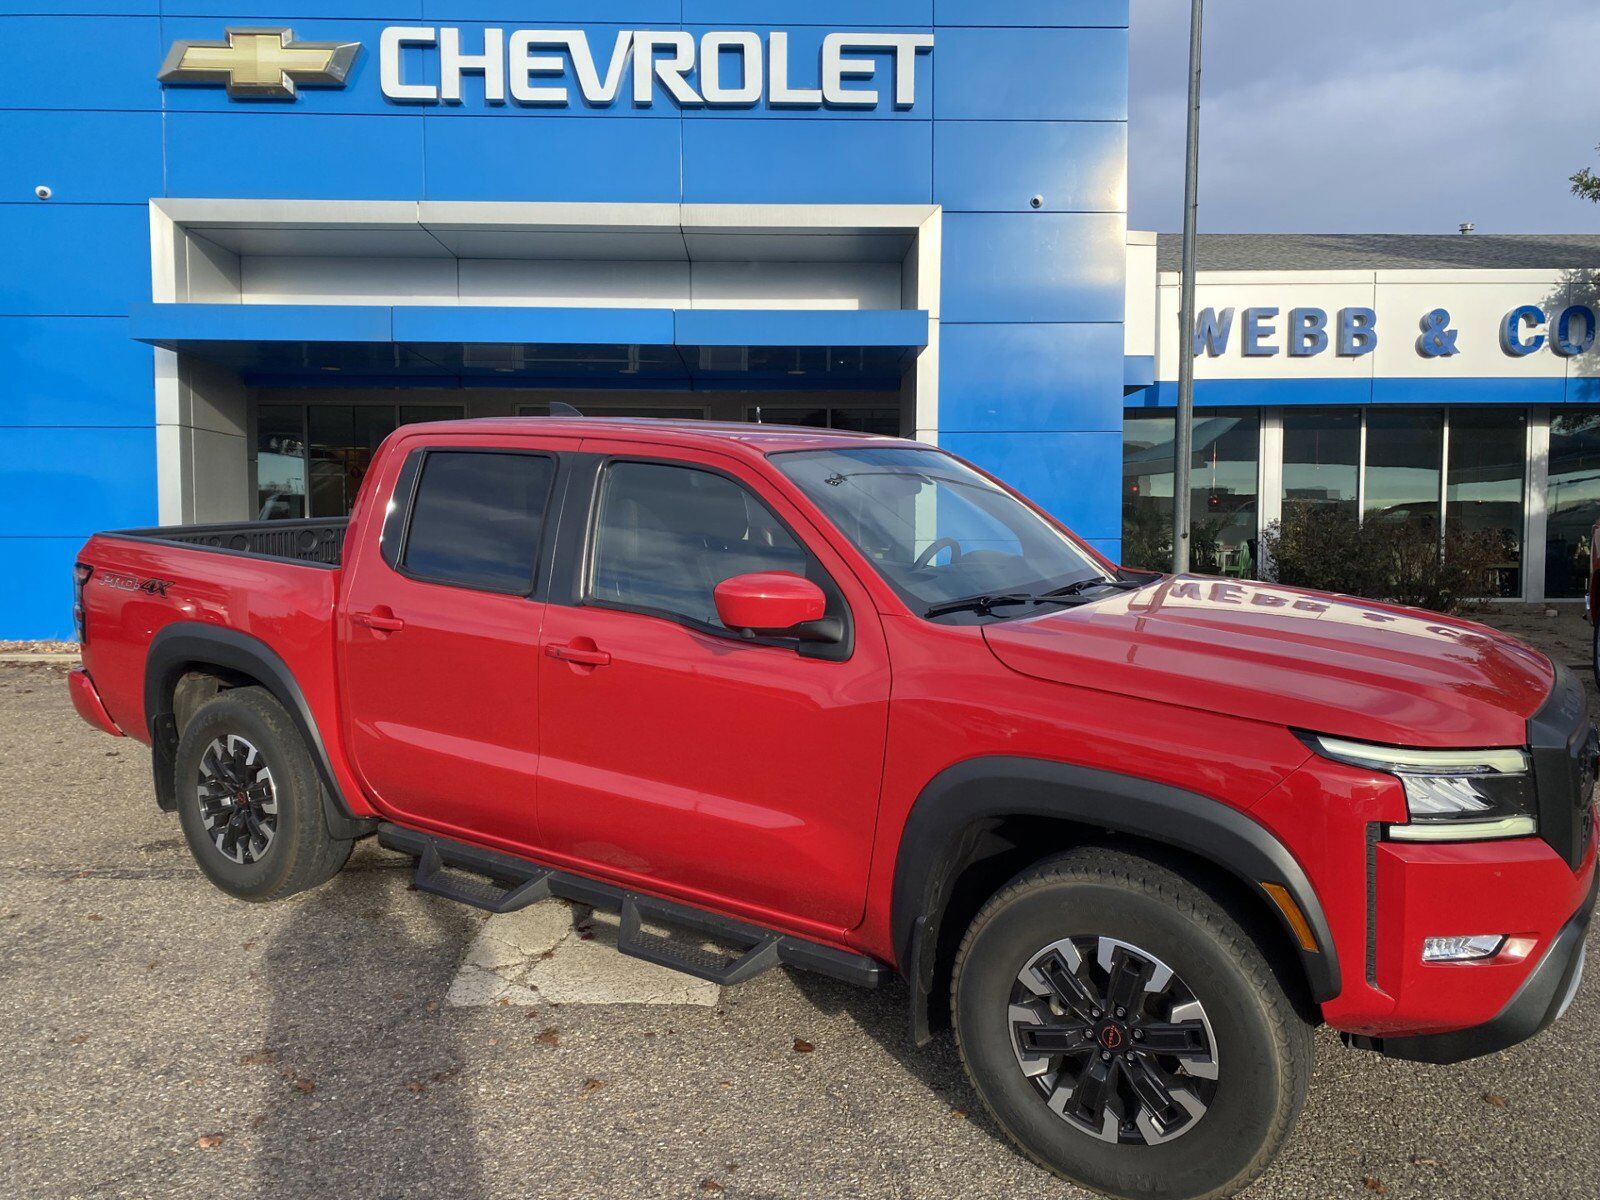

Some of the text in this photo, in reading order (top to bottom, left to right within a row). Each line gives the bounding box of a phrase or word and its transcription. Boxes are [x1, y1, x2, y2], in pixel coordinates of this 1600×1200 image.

[379, 26, 935, 108] CHEVROLET
[1192, 304, 1596, 359] WEBB & CO
